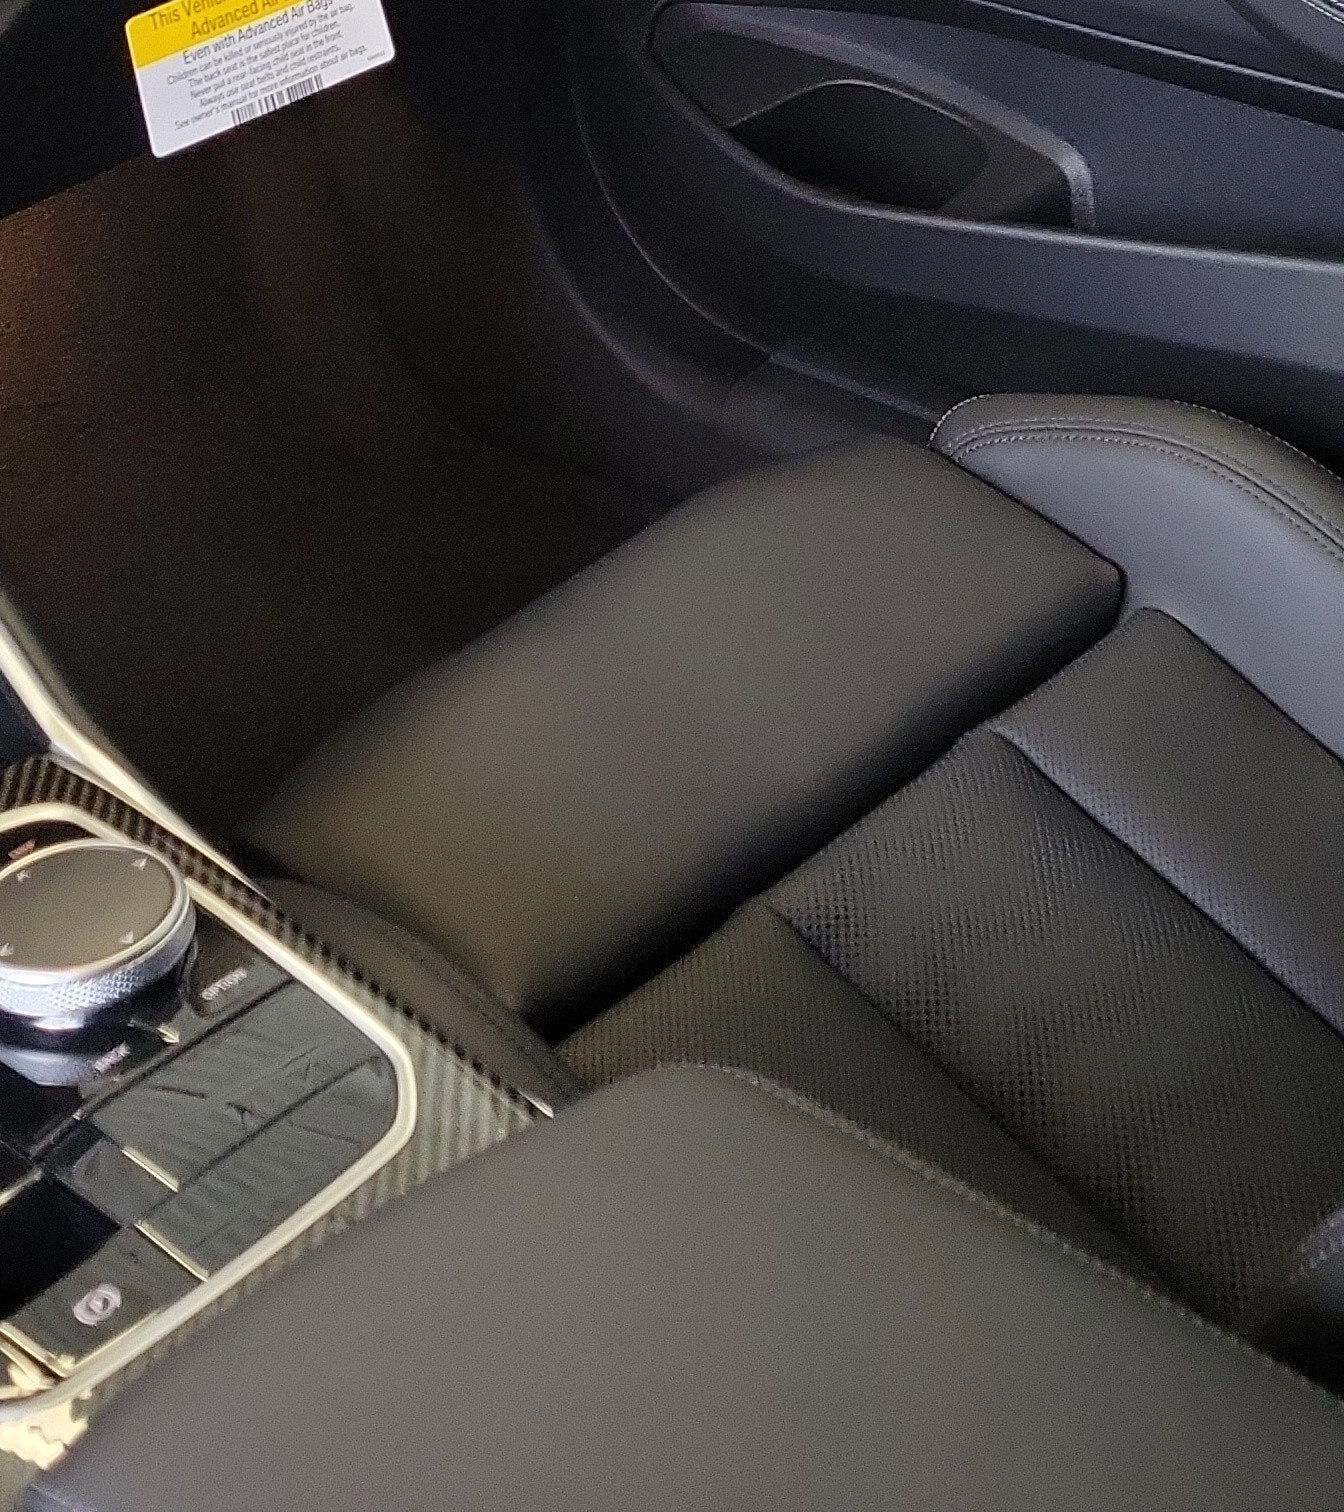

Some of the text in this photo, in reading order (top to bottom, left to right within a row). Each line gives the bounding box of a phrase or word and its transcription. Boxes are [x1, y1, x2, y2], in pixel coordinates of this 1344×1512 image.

[149, 9, 181, 29] This
[182, 45, 211, 65] Even
[212, 33, 236, 53] with
[238, 8, 290, 43] Advanced
[291, 3, 304, 20] Air
